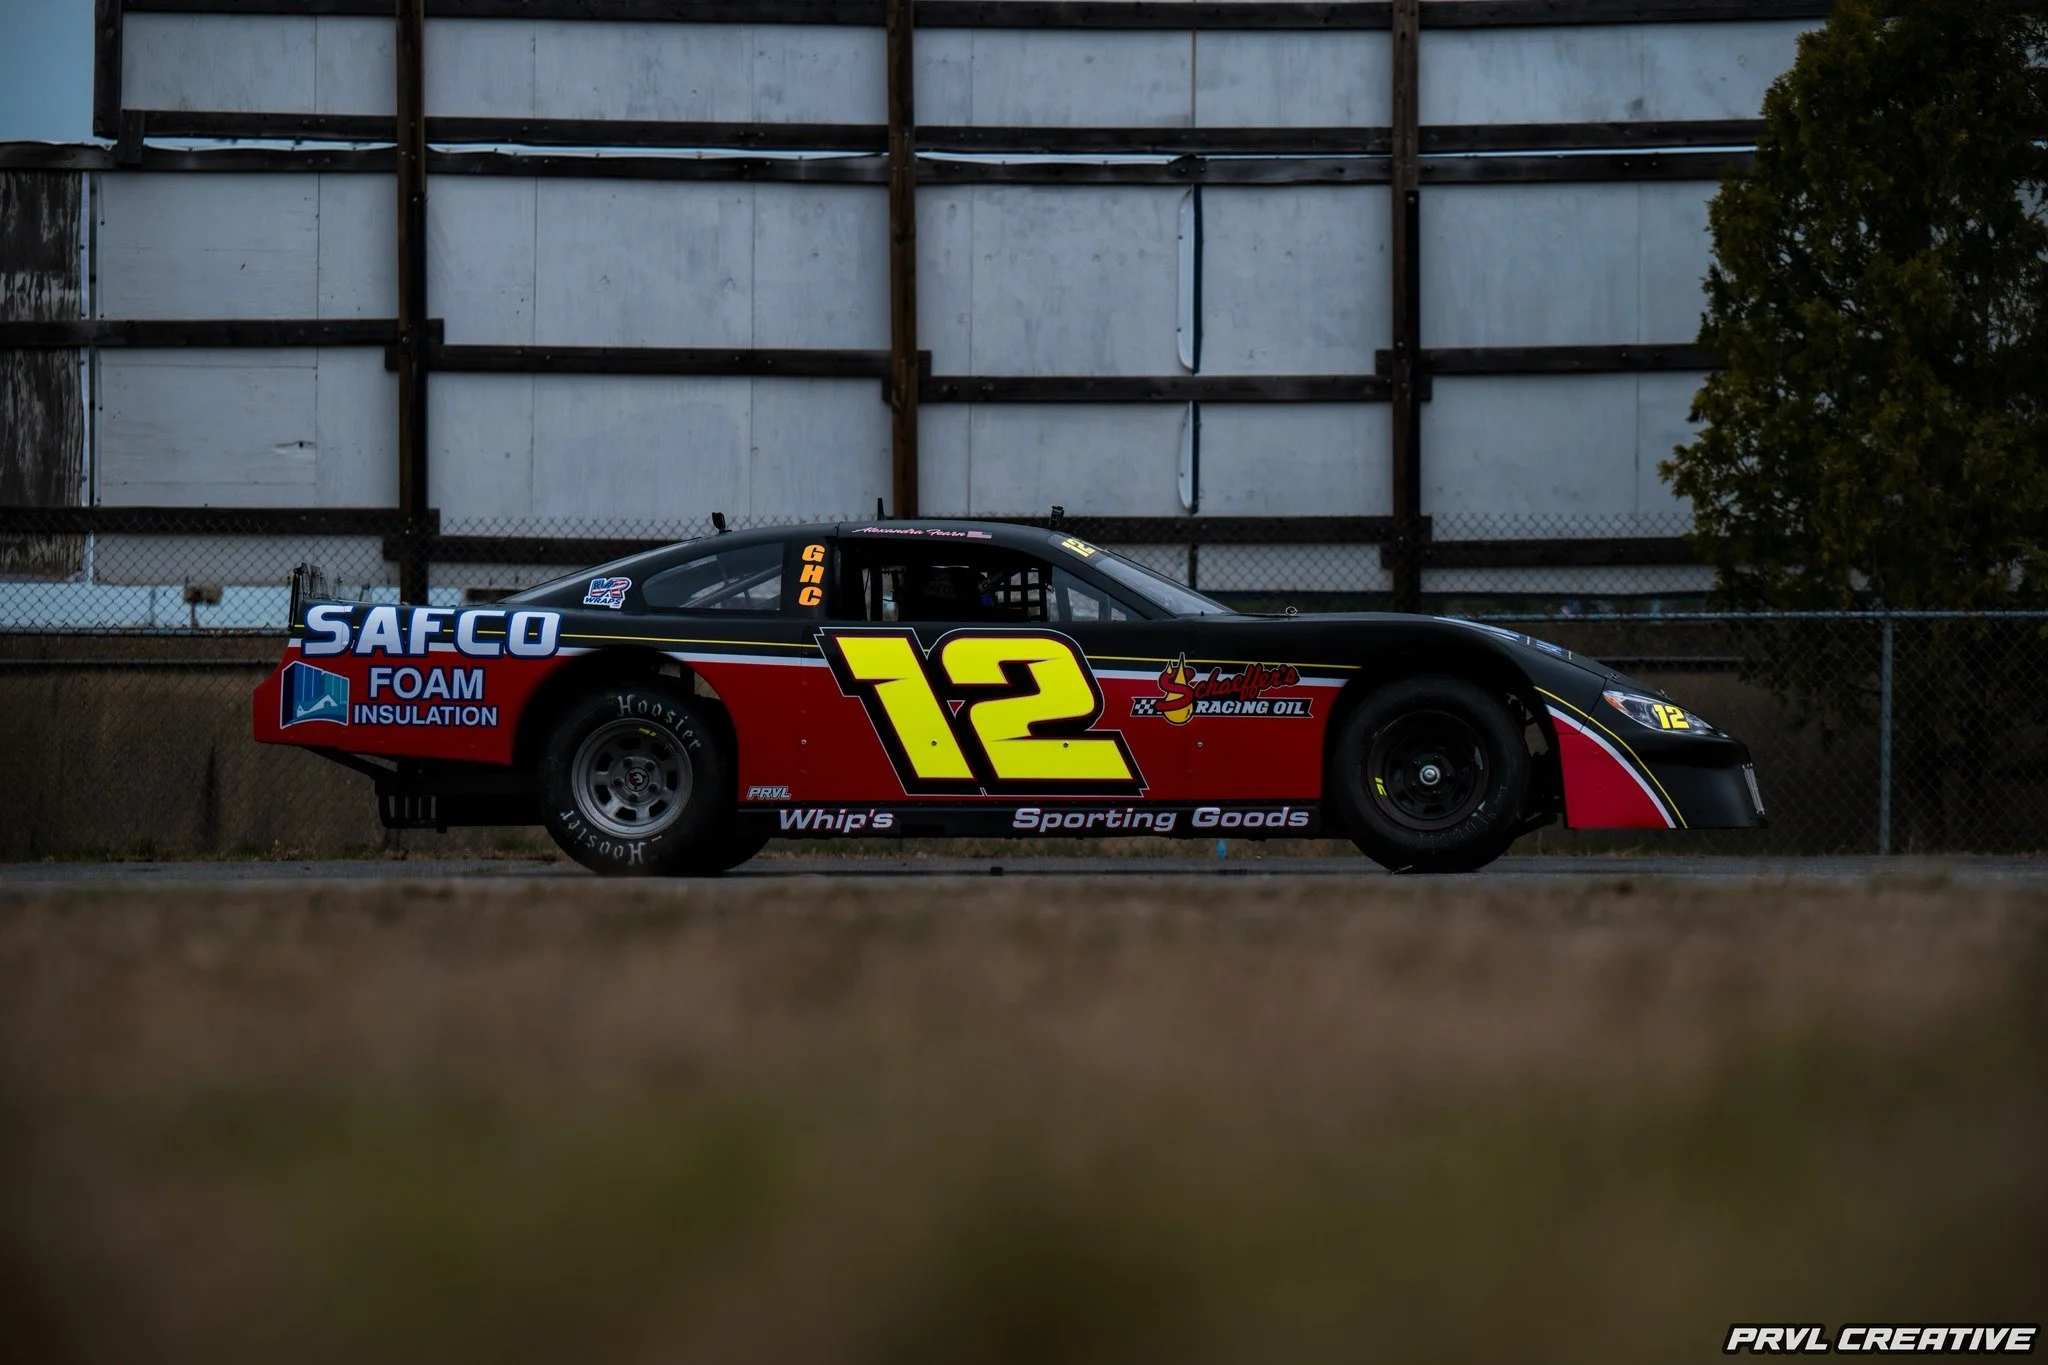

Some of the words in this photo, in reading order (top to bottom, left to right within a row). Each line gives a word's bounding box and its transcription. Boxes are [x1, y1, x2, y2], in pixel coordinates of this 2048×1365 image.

[1061, 538, 1096, 558] 12
[585, 597, 622, 605] WRAPS
[304, 605, 561, 657] SAFCO
[369, 667, 484, 700] FOAM
[1155, 662, 1299, 711] Schaeffer's
[354, 705, 498, 727] INSULATION
[617, 693, 703, 749] Hoosier
[830, 633, 1138, 784] 12
[1196, 700, 1269, 715] RACING
[1272, 700, 1306, 715] OIL
[1652, 703, 1690, 730] 12
[748, 786, 791, 800] PRVL
[779, 807, 894, 833] Whip's
[1012, 807, 1178, 833] Sporting
[1191, 805, 1310, 828] Goods
[559, 810, 648, 866] Hoosier
